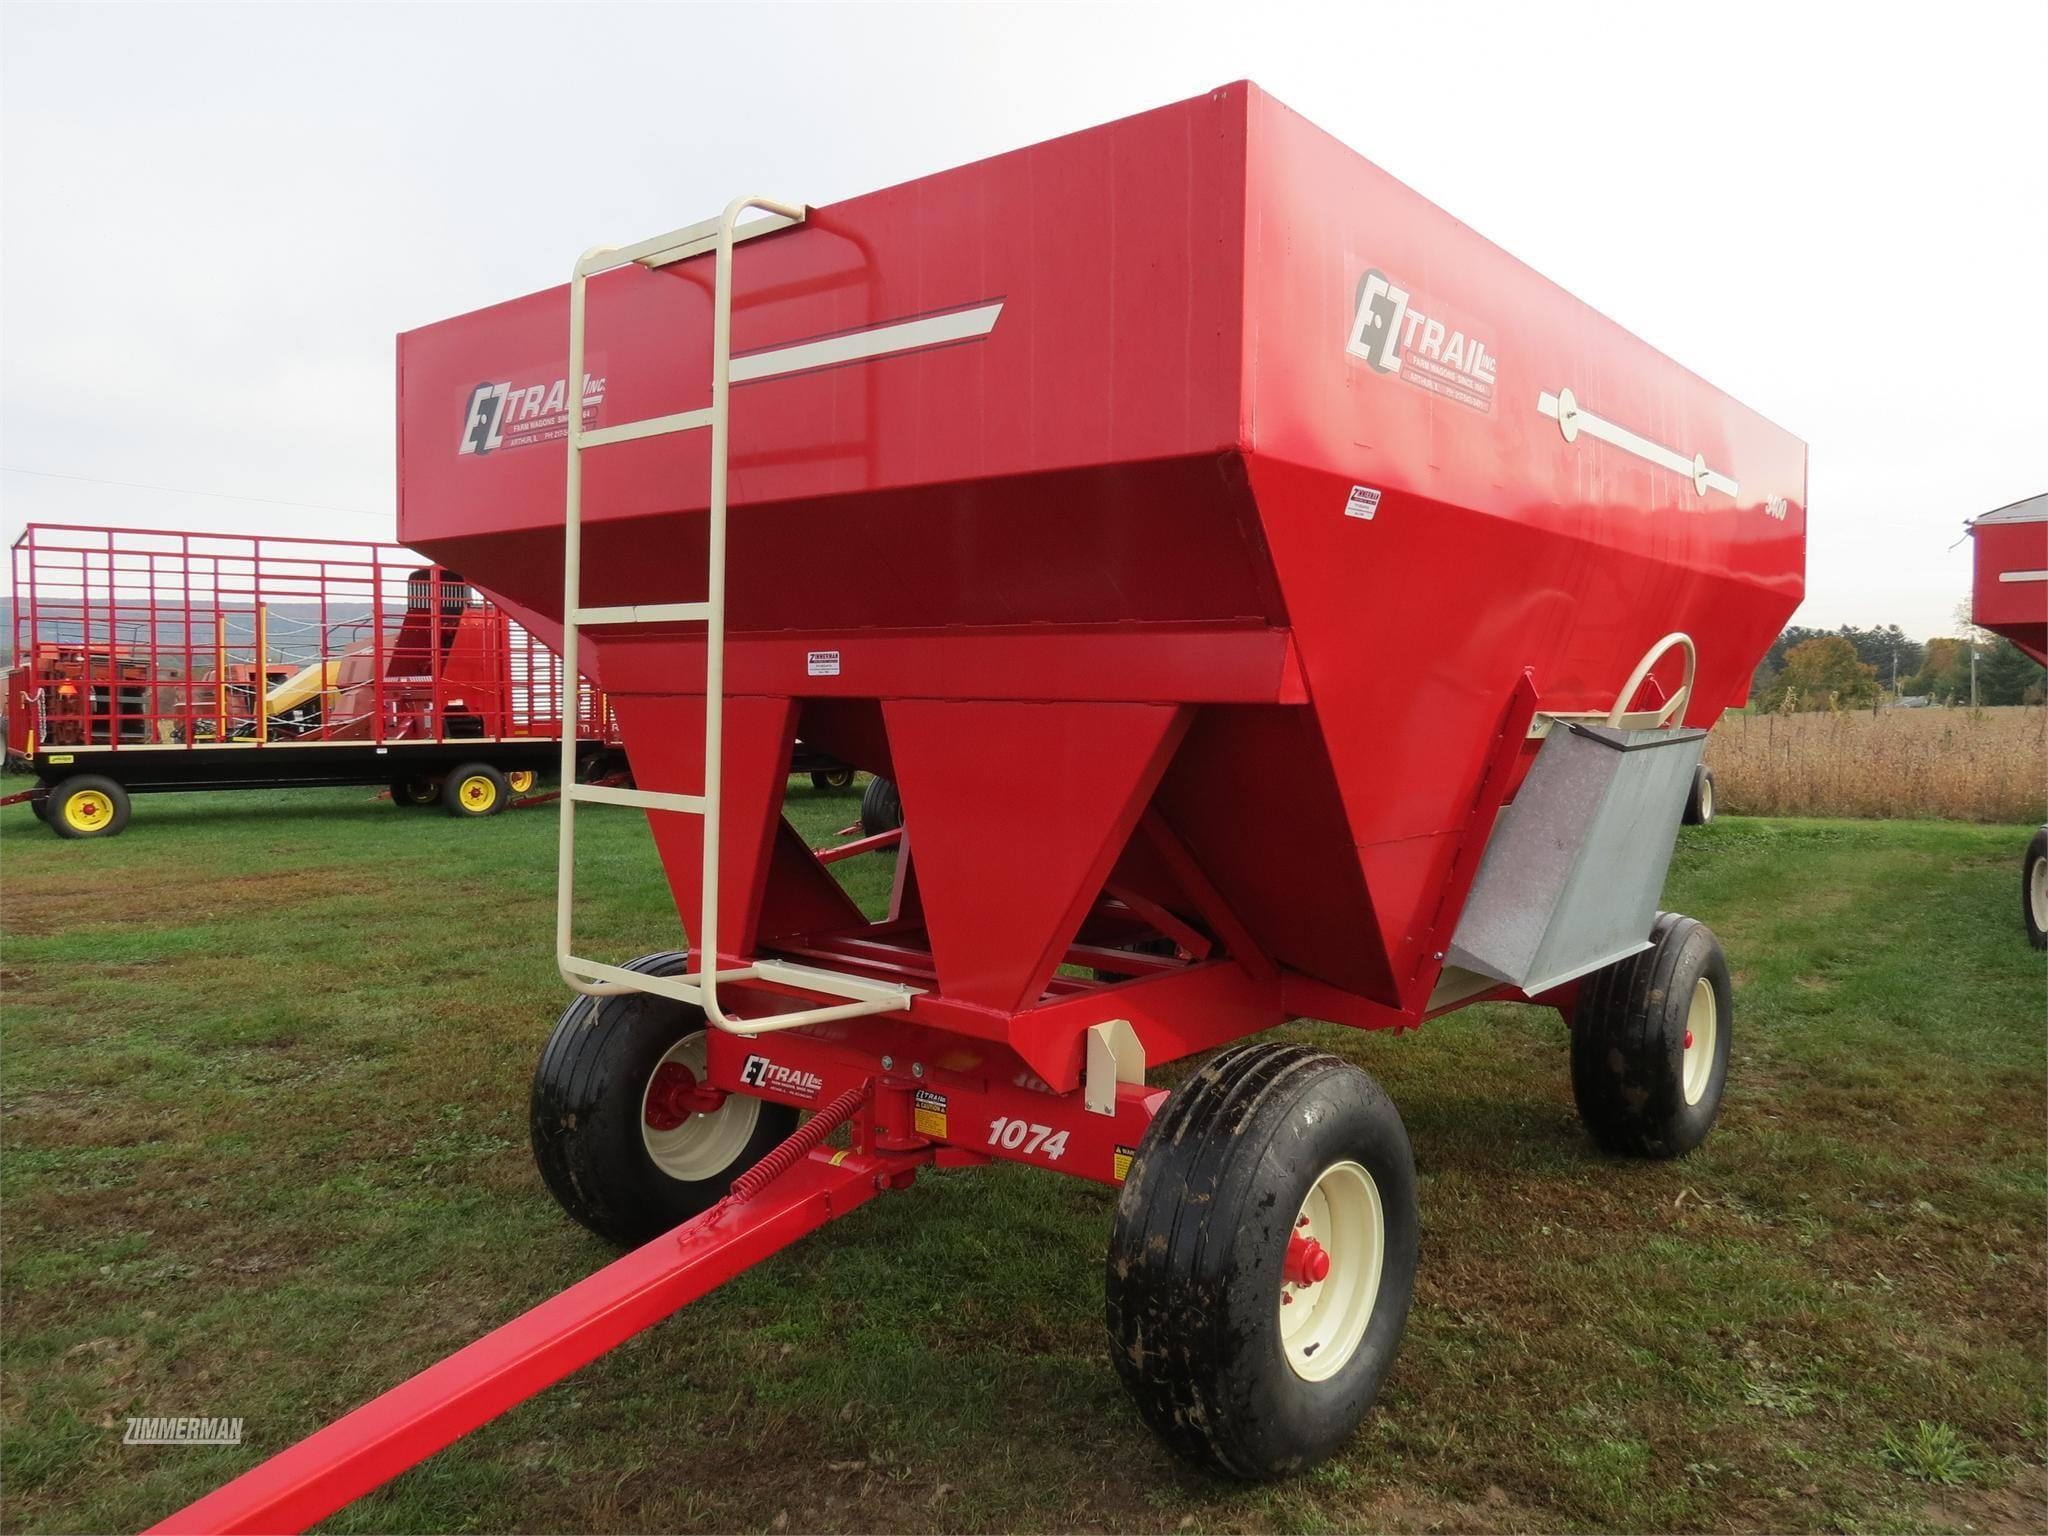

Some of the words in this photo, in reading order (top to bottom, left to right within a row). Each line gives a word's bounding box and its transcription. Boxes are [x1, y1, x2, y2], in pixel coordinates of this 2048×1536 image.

[1404, 308, 1495, 384] TRAIL
[505, 374, 603, 423] TRAL
[513, 422, 529, 432] FARM
[530, 417, 555, 430] WAGONS
[767, 1064, 822, 1090] TRAIL
[987, 1116, 1071, 1161] 1074
